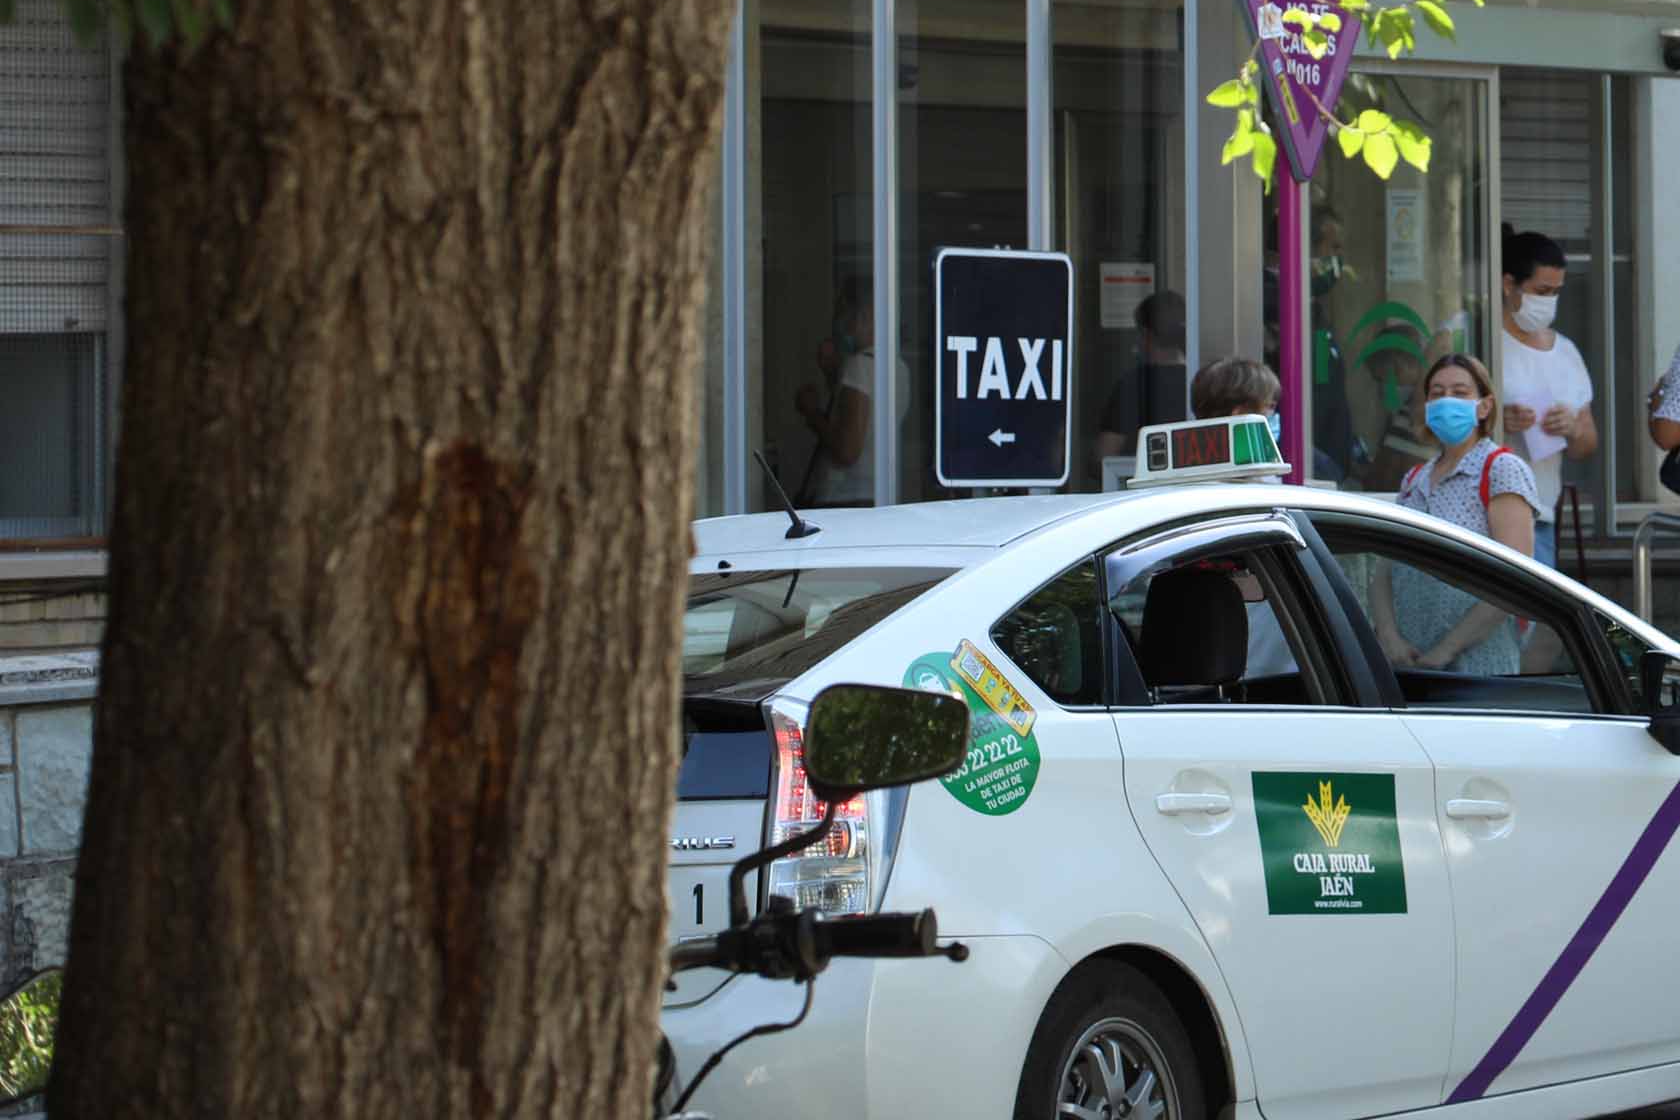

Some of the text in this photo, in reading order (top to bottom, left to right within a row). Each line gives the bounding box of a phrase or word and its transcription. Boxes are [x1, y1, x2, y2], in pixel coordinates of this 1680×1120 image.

[1280, 31, 1337, 56] CALS
[1296, 63, 1321, 85] 016
[947, 336, 1063, 401] TAXI
[1173, 425, 1229, 467] TAXI
[984, 741, 1006, 763] 22
[1001, 734, 1022, 755] 22
[965, 781, 977, 793] LA
[976, 767, 1006, 787] MAYOR
[1005, 757, 1030, 776] FLOTA
[980, 773, 1022, 799] DE TAXI DE
[985, 787, 1026, 810] TU CIUDAD
[1293, 853, 1376, 874] CAJA RURAL
[1320, 873, 1355, 897] JAÉN
[693, 883, 703, 925] 1
